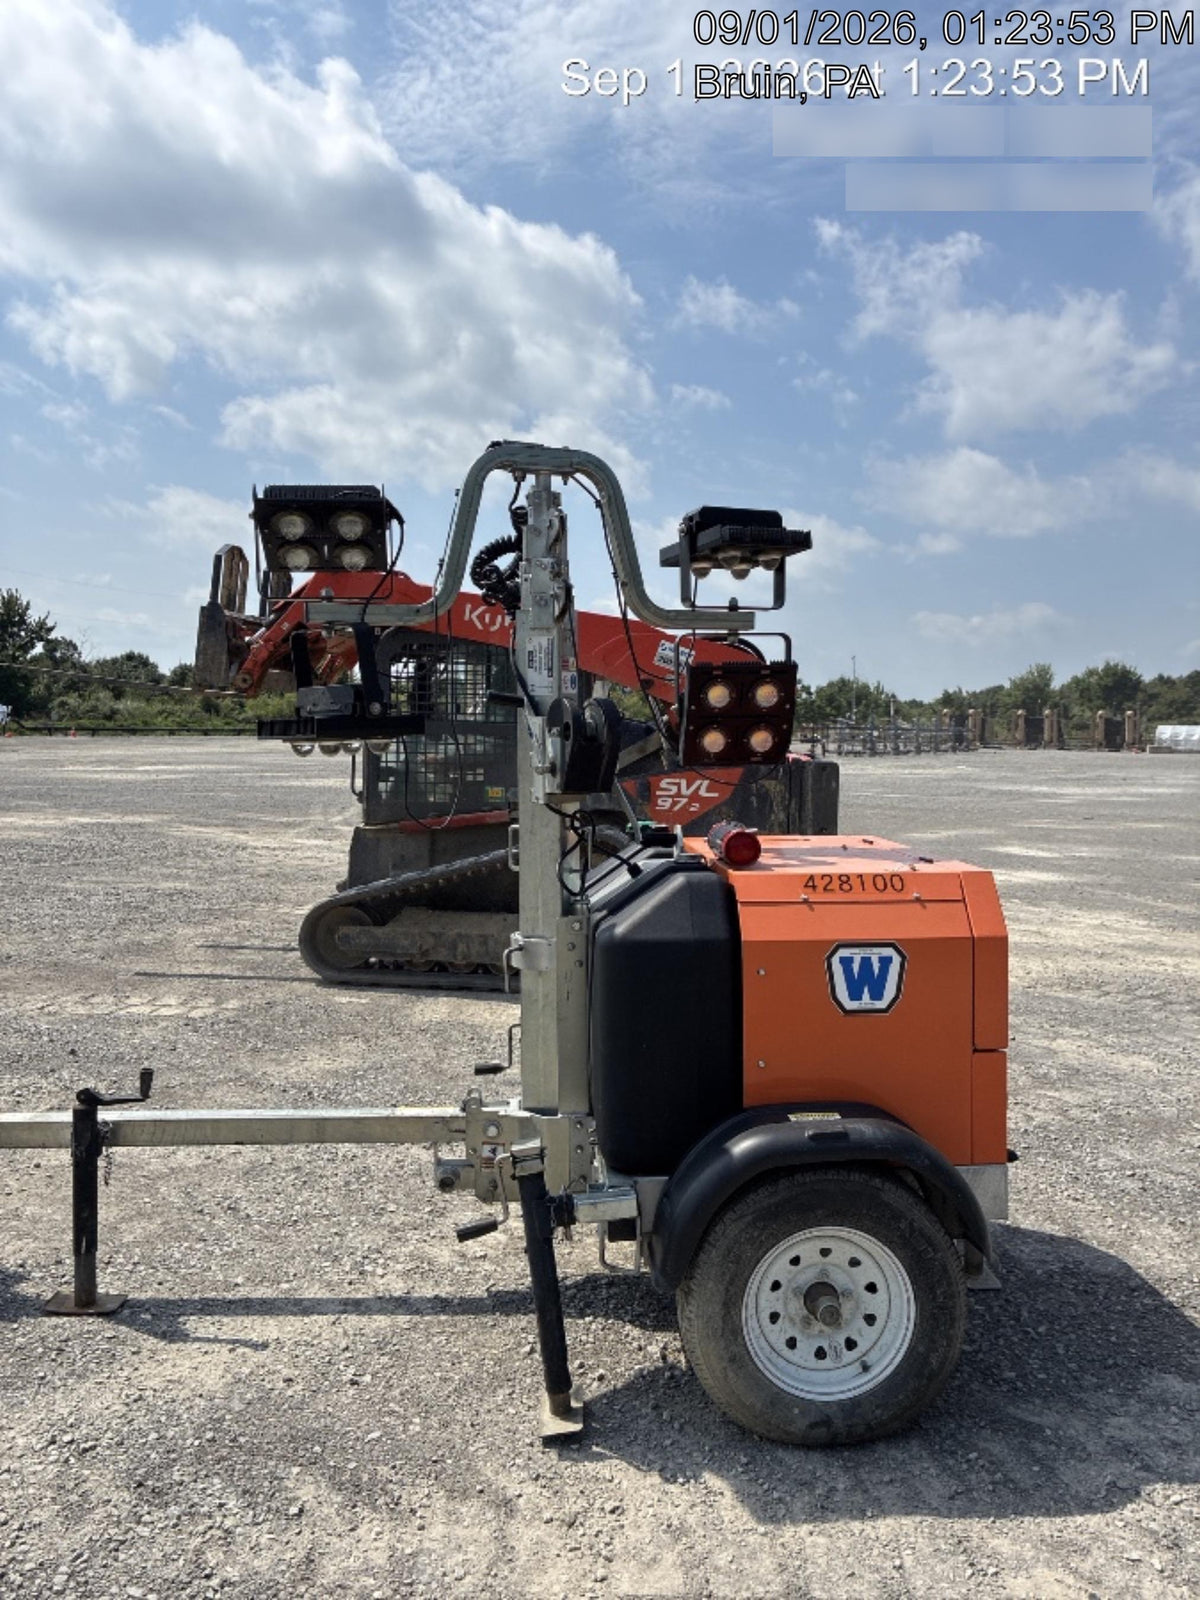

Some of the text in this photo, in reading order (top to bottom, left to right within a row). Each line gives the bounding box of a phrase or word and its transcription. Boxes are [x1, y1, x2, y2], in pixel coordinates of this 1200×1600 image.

[655, 778, 719, 797] SVL
[803, 874, 904, 892] 428100
[839, 956, 893, 1001] W
